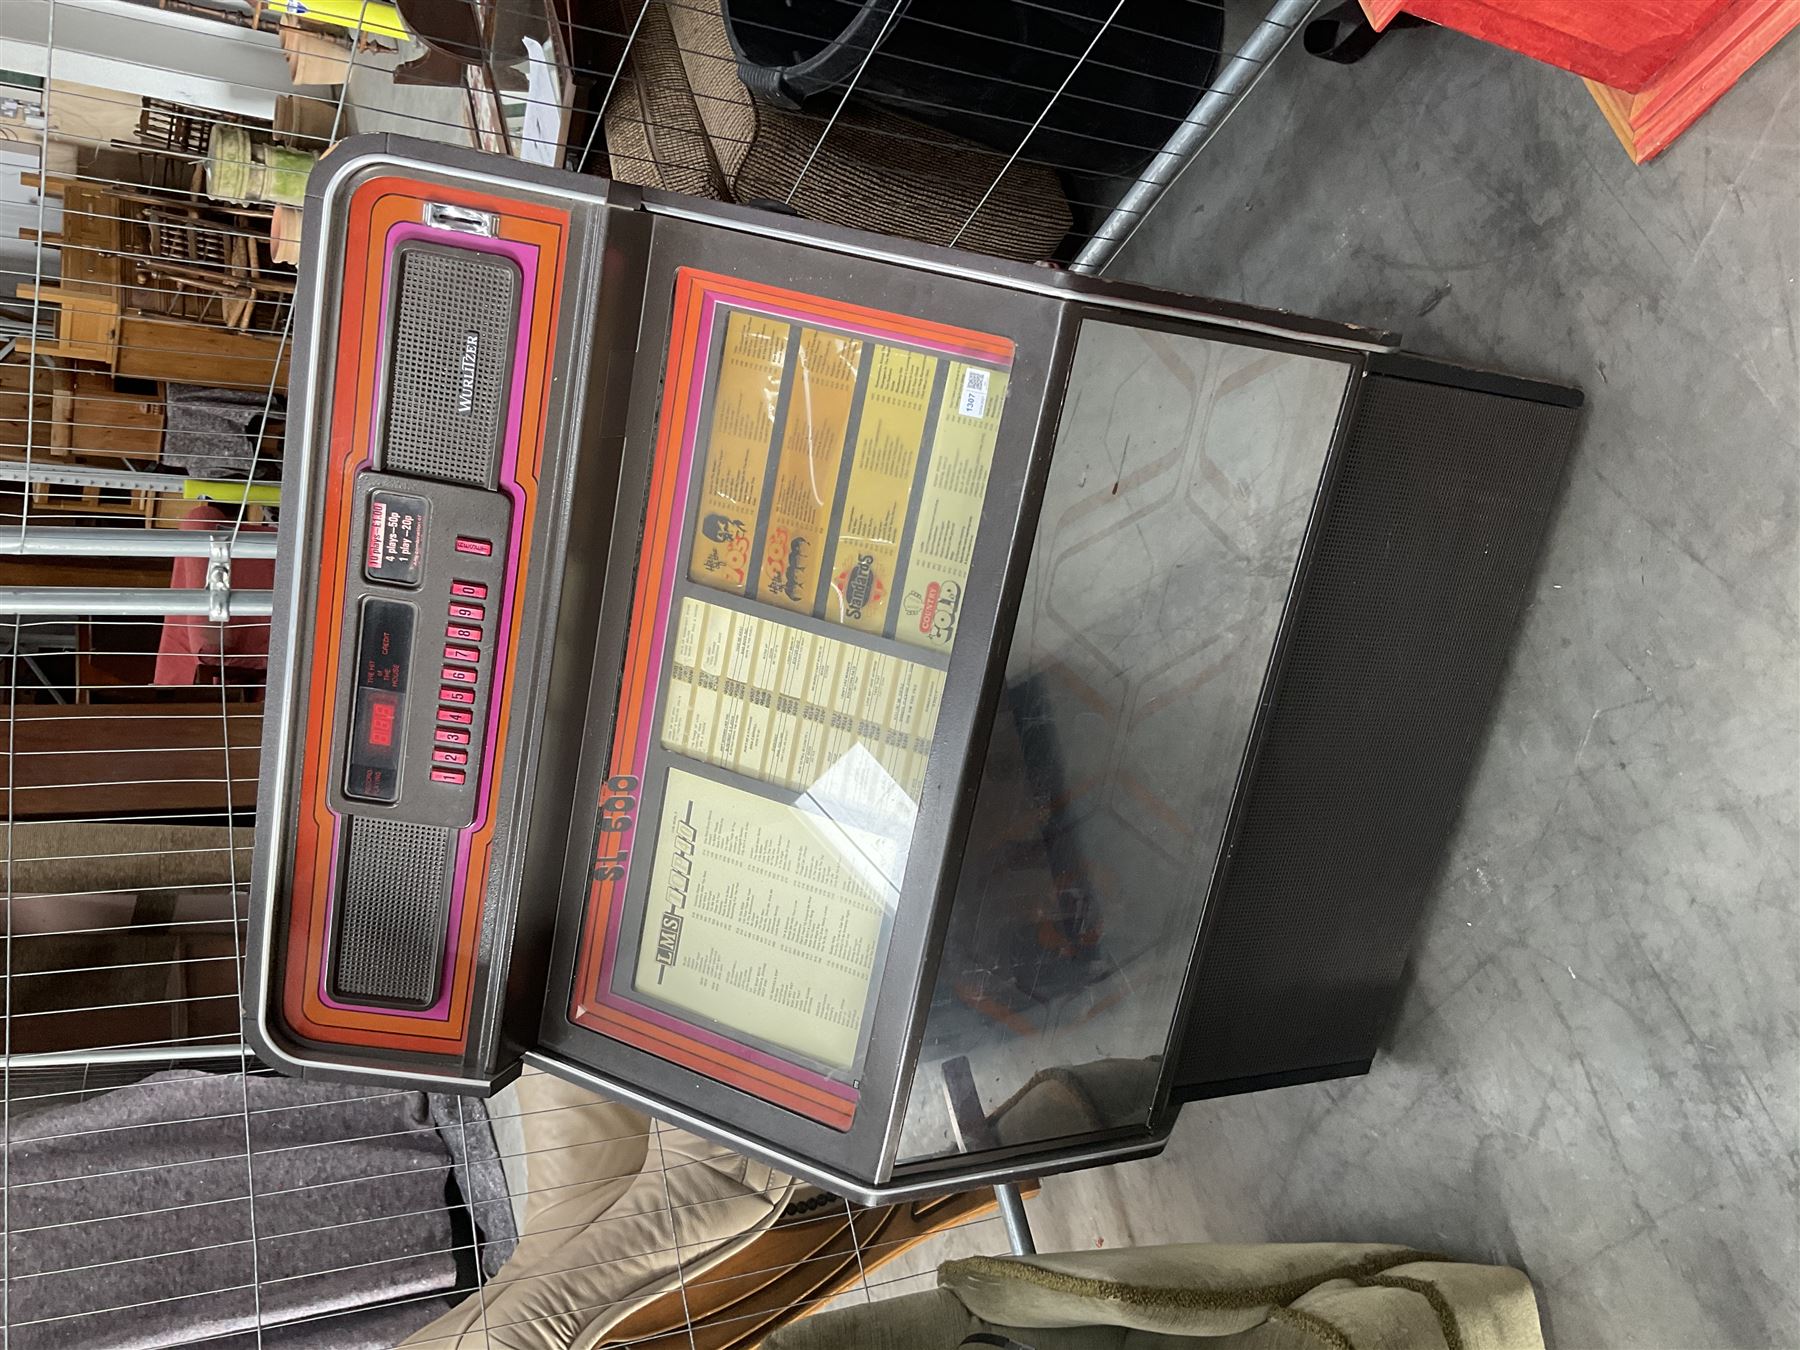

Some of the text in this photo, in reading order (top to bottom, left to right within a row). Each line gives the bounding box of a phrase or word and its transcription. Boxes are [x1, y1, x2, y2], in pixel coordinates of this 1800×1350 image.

[458, 336, 478, 412] WURLITZER
[966, 393, 975, 412] 1307
[400, 538, 412, 555] play
[462, 586, 475, 594] 0
[846, 553, 874, 620] Standards
[458, 608, 471, 616] 9
[921, 587, 938, 630] COUNTRY
[931, 580, 962, 644] GOLD
[381, 632, 390, 655] CREDIT
[458, 629, 471, 637] 8
[452, 672, 465, 680] 6
[592, 850, 629, 881] SL
[657, 916, 681, 966] LMS
